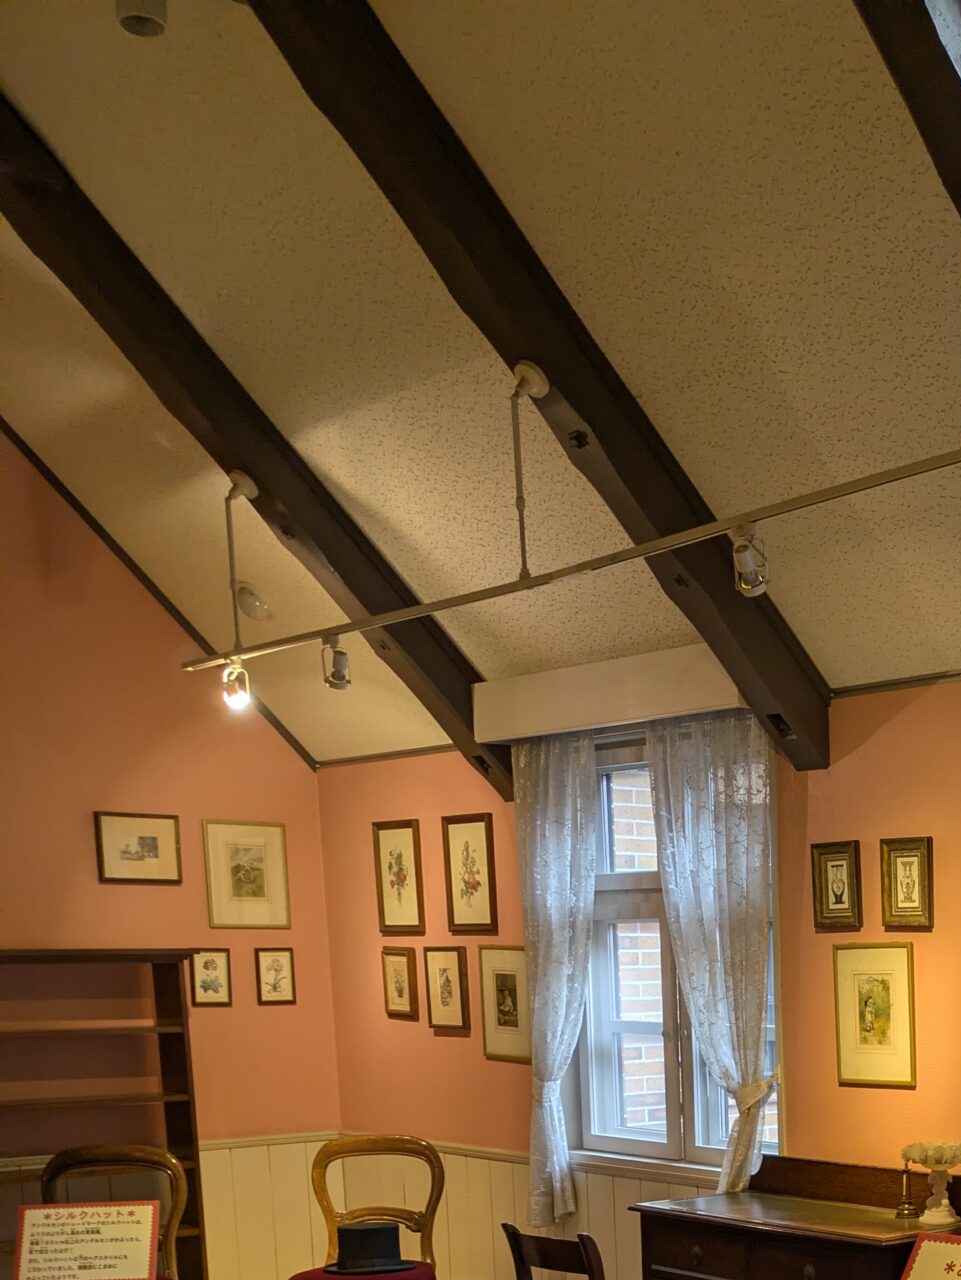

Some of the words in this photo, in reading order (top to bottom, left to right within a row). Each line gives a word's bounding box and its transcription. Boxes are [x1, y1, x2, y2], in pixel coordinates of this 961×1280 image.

[54, 1211, 124, 1220] シルクハット
